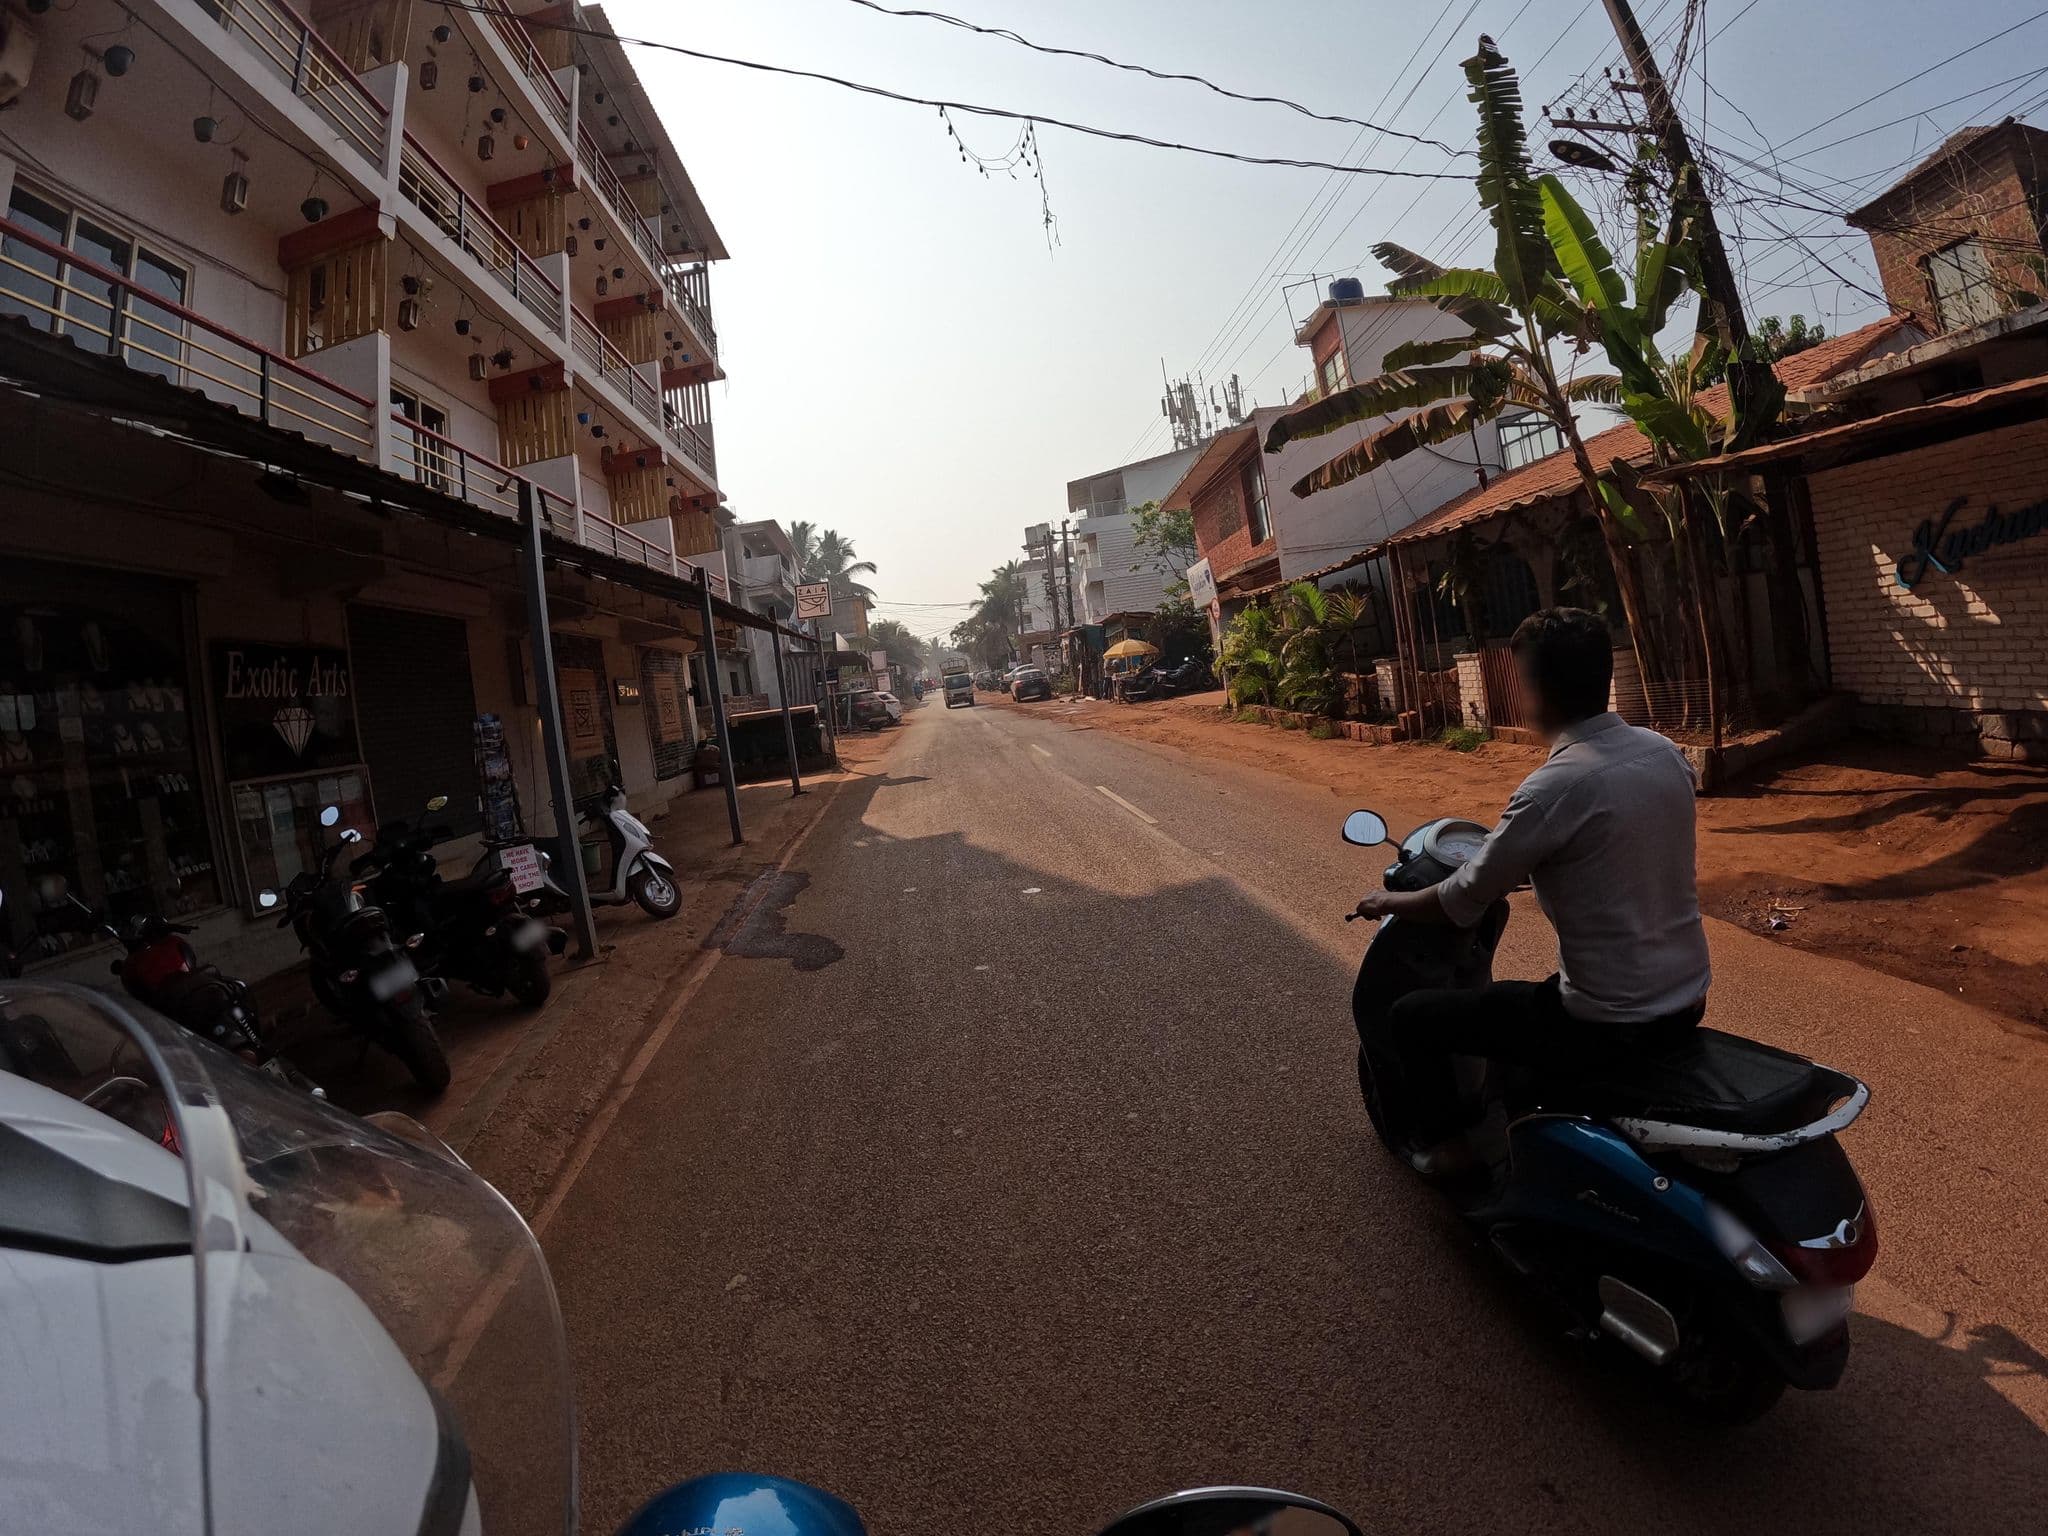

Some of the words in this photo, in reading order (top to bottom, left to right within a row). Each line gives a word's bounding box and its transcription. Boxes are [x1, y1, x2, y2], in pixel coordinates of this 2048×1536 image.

[798, 587, 827, 595] ZAIA
[225, 650, 299, 698] Exotic
[306, 655, 349, 697] Arts
[512, 874, 527, 882] SIDE
[518, 881, 534, 889] SHOP
